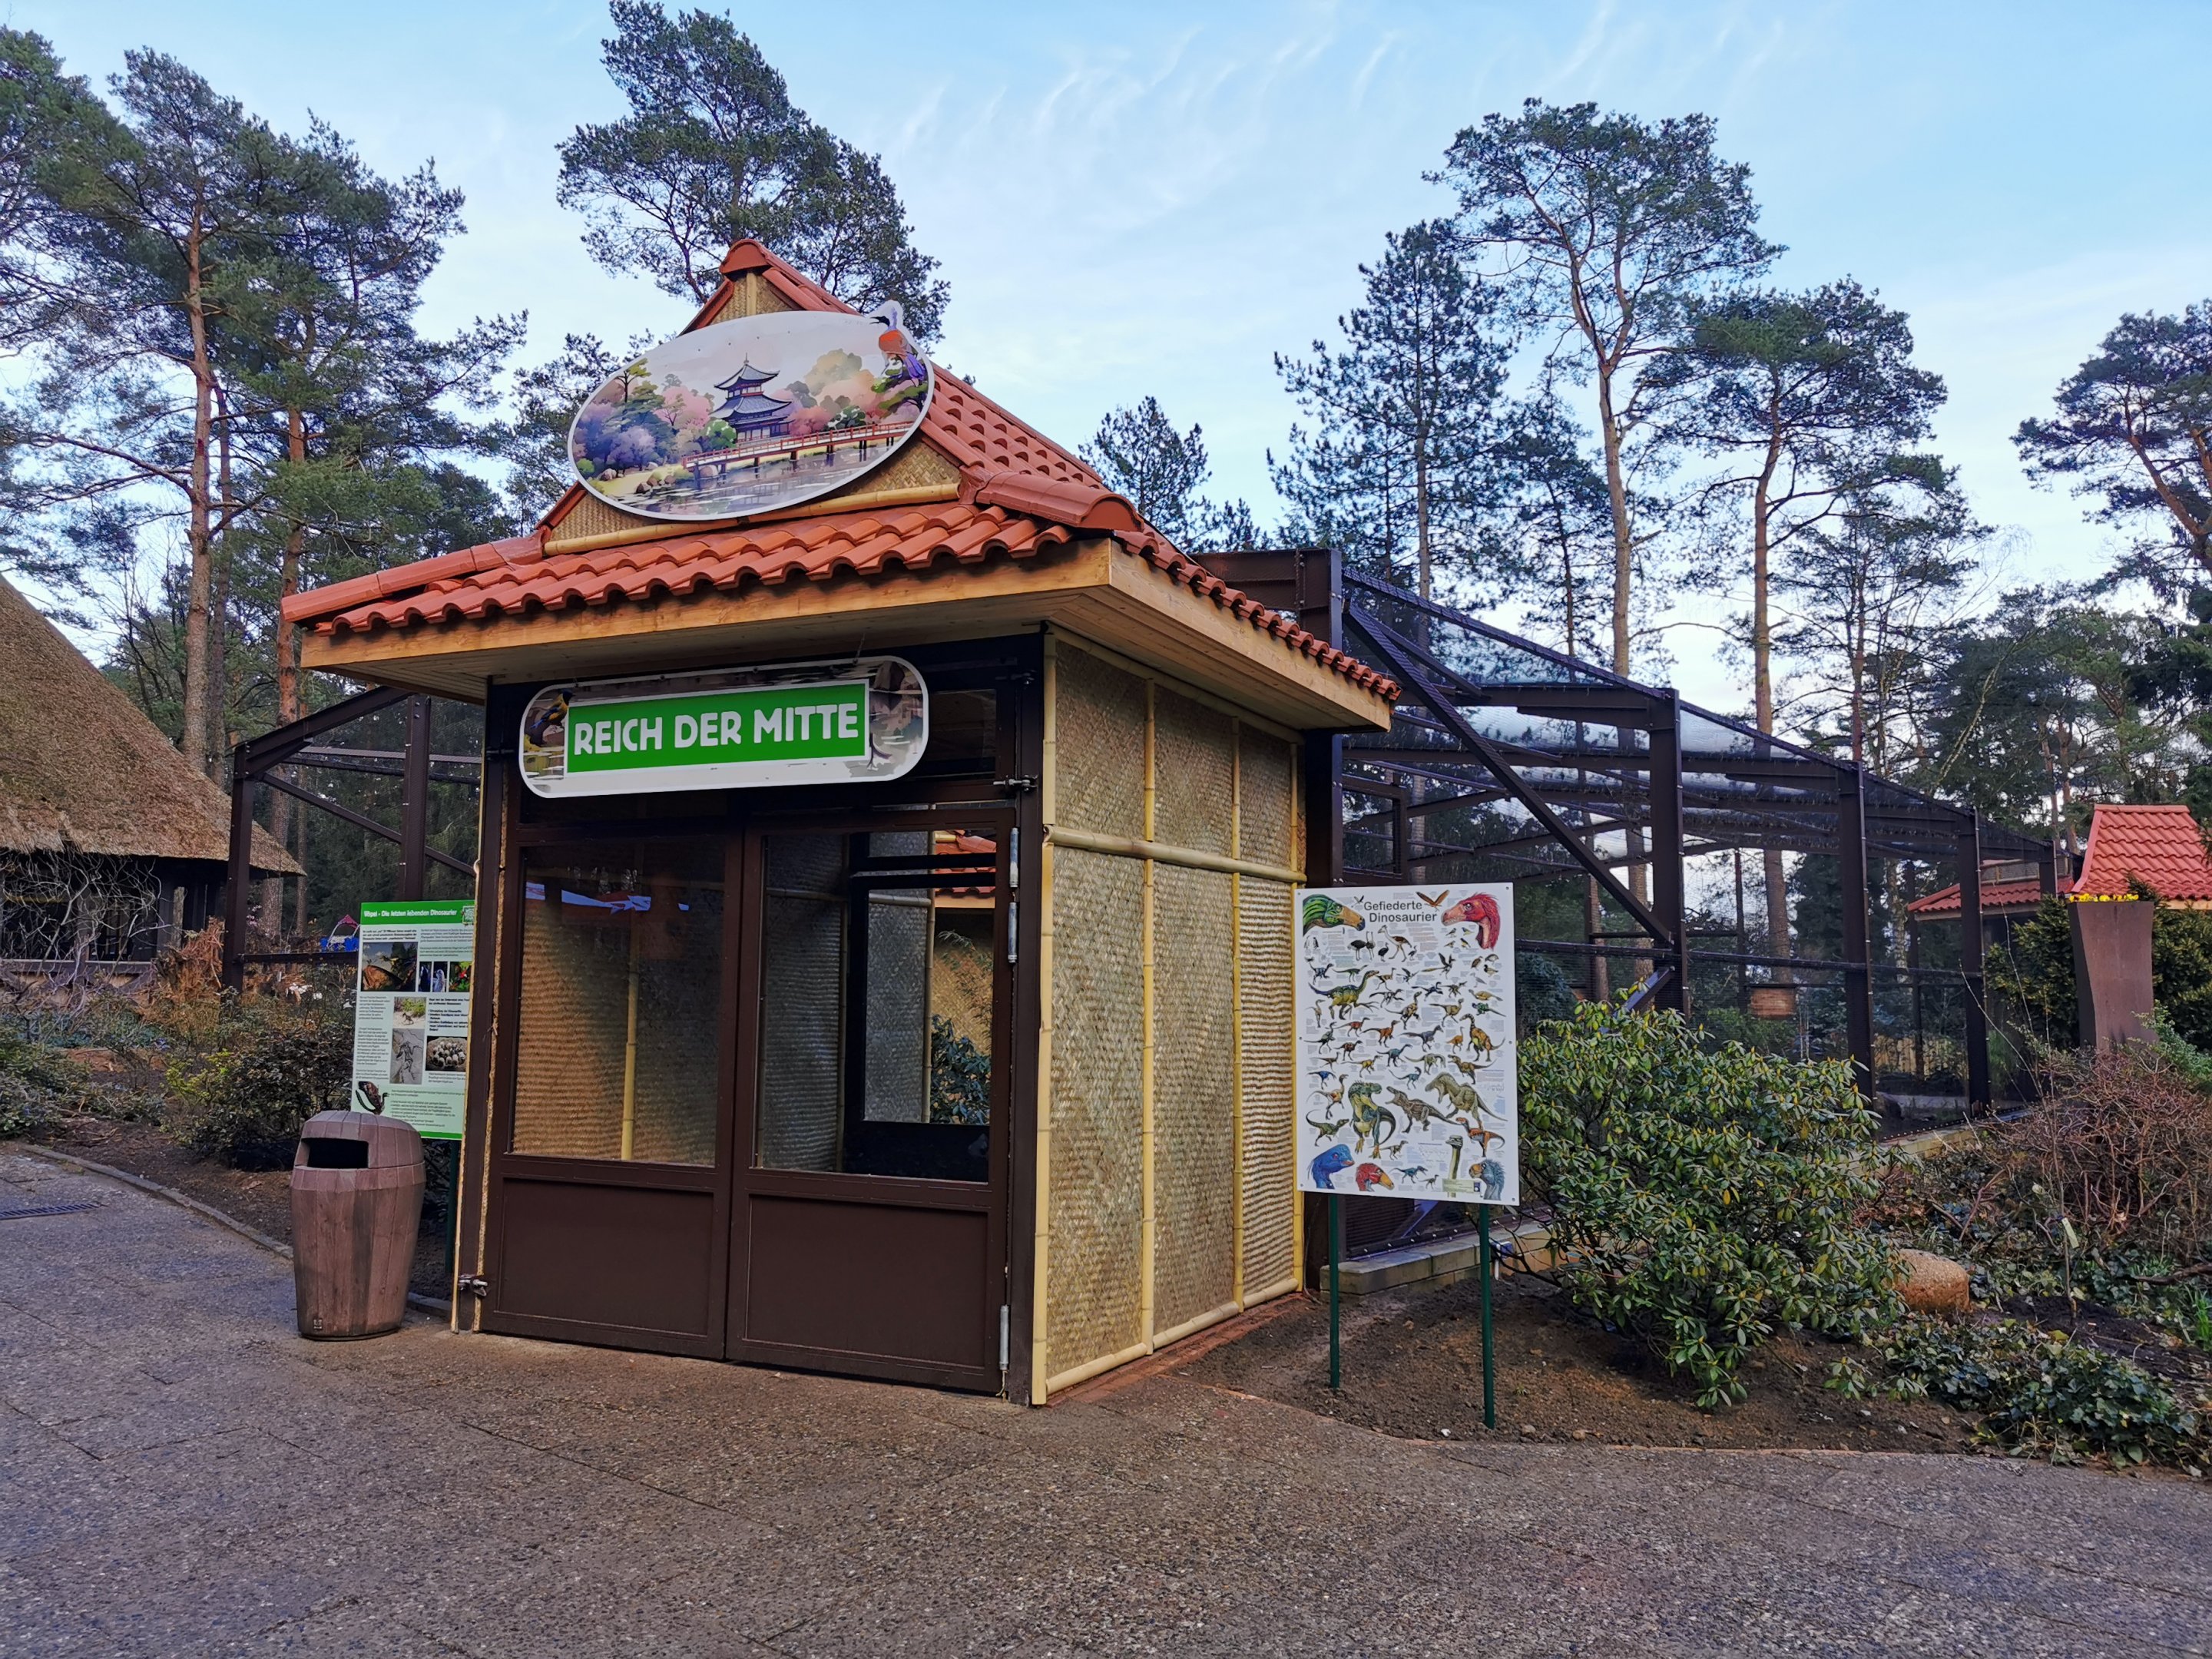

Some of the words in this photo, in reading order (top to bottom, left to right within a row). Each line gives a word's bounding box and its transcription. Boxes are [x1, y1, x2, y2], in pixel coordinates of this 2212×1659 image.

[574, 717, 663, 755] REICH
[674, 710, 742, 748] DER
[753, 703, 859, 743] MITTE
[1363, 900, 1422, 911] Gefiederte
[1369, 912, 1438, 922] Dinosaurier
